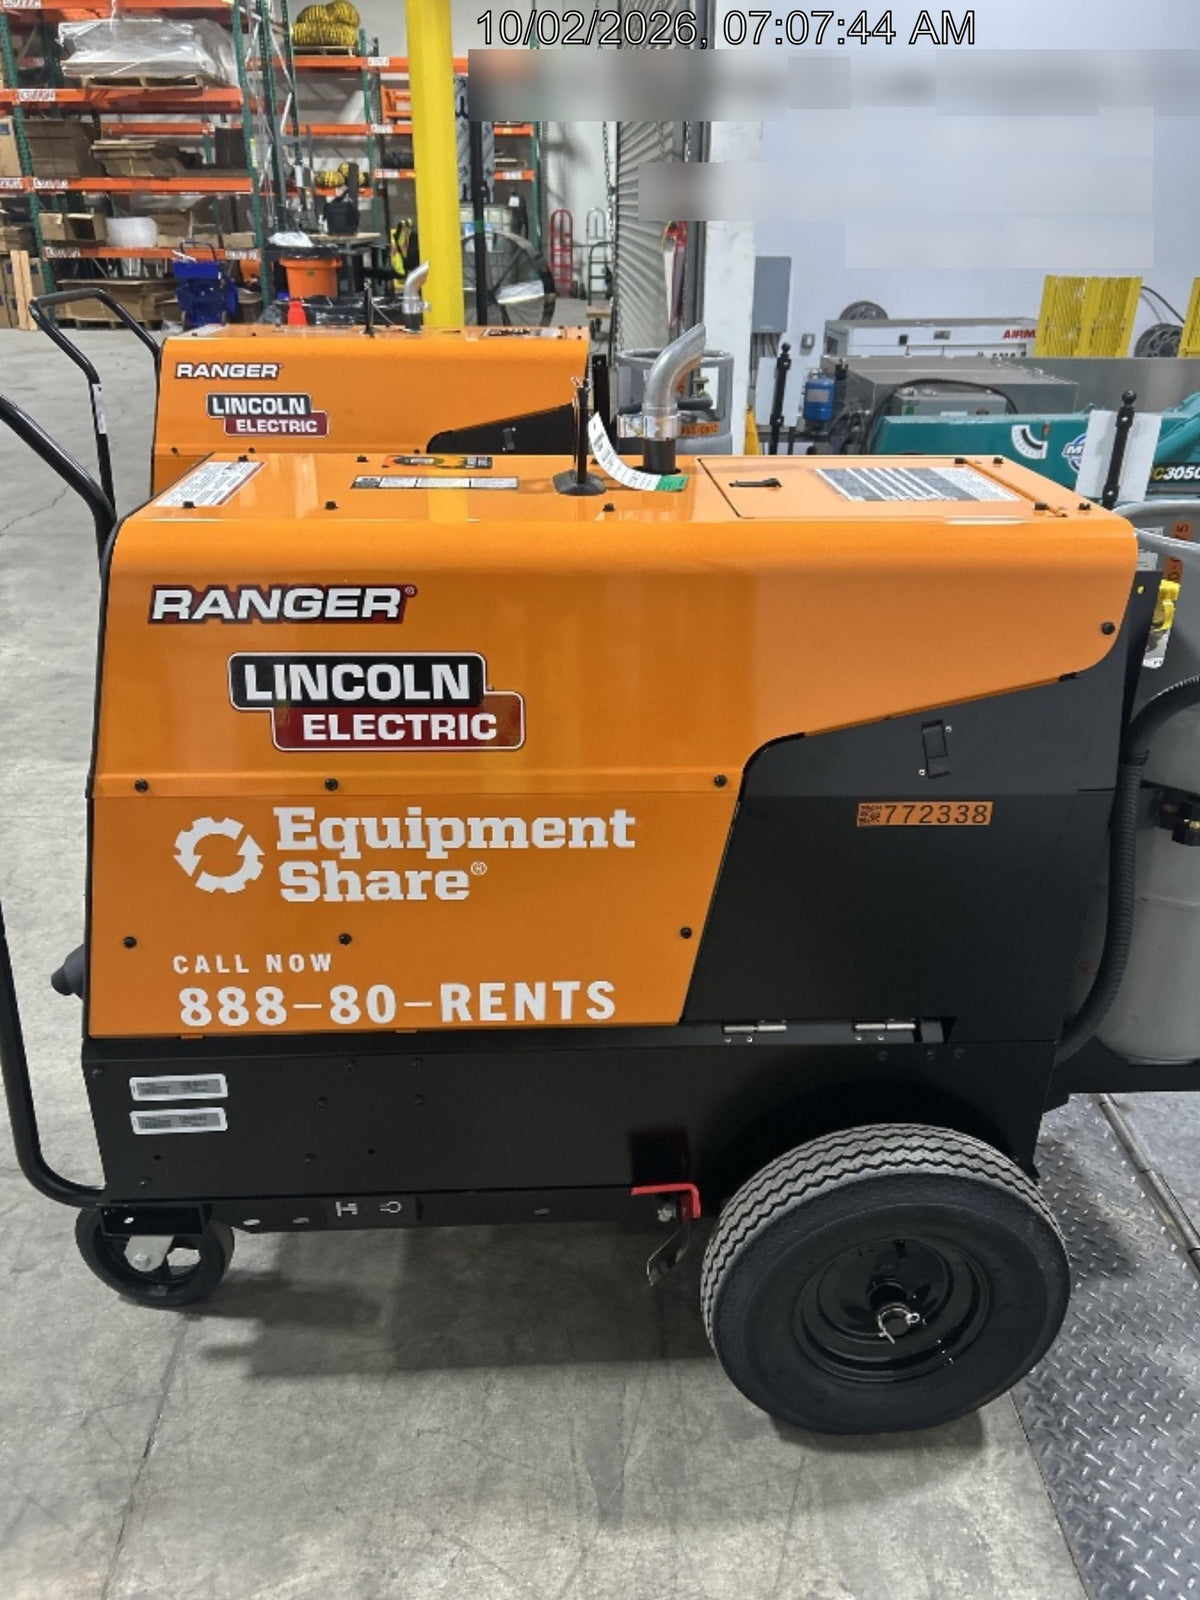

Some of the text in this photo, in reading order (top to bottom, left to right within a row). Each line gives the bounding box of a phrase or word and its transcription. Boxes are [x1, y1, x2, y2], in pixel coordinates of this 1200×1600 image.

[1002, 328, 1036, 340] AIRM
[211, 396, 306, 415] LINCOLN
[234, 418, 318, 433] ELECTRIC
[244, 663, 470, 701] LINCOLN
[302, 712, 498, 741] ELECTRIC
[884, 804, 988, 825] 772338
[272, 806, 636, 860] Equipment
[172, 952, 333, 975] CALL NOW
[178, 980, 616, 1027] 888-80-RENTS
